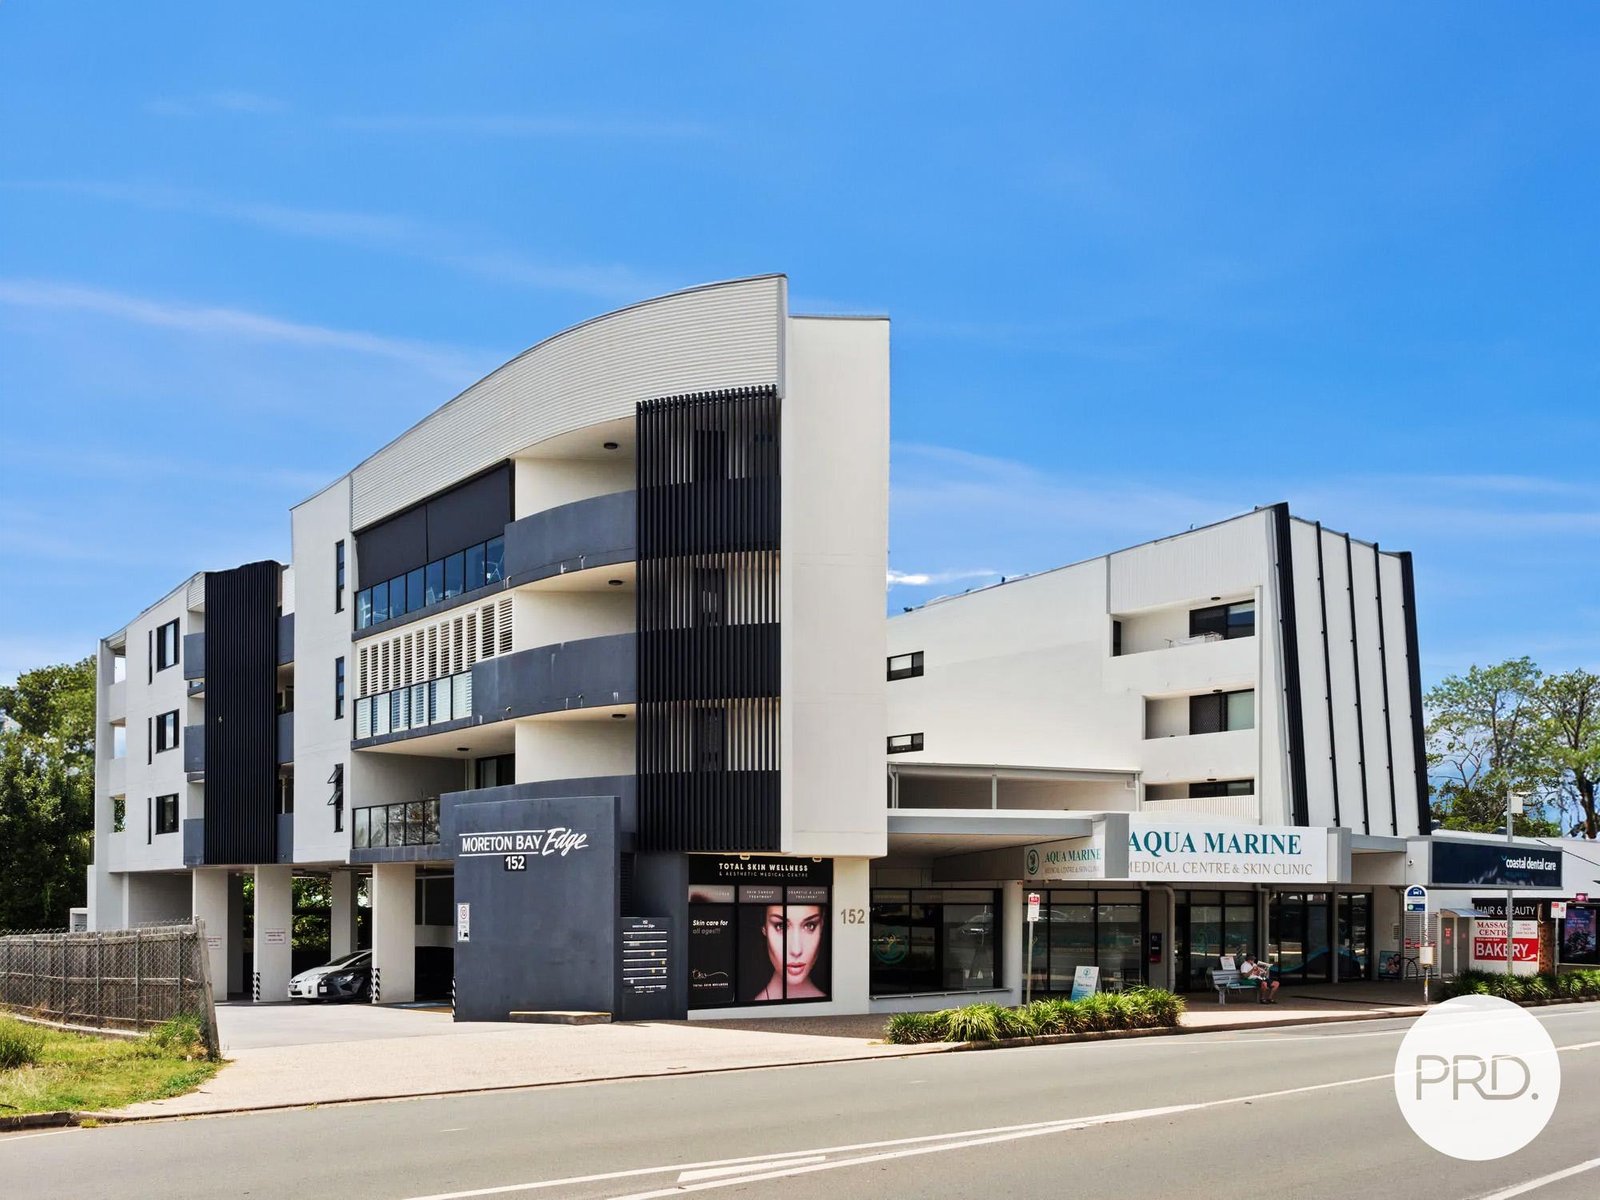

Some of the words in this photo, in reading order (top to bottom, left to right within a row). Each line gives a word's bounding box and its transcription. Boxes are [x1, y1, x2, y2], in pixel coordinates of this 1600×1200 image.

[462, 835, 512, 852] MORETON
[515, 835, 543, 850] BAY
[541, 827, 589, 857] Edge
[1128, 831, 1196, 858] AQUA
[1204, 832, 1302, 855] MARINE
[505, 855, 526, 870] 152
[1045, 851, 1067, 864] AQUA
[1068, 848, 1101, 861] MARINE
[1506, 856, 1526, 869] coastal
[1526, 857, 1545, 870] dental
[1544, 861, 1557, 871] care
[747, 863, 766, 871] SKIN
[769, 864, 809, 872] WELLNESS
[1183, 862, 1230, 875] CENTRE
[1243, 863, 1271, 876] SKIN
[1273, 864, 1313, 876] CLINIC
[840, 909, 865, 924] 152
[1476, 906, 1495, 914] HAIR
[1496, 906, 1503, 916] &
[1476, 942, 1529, 958] BAKERY
